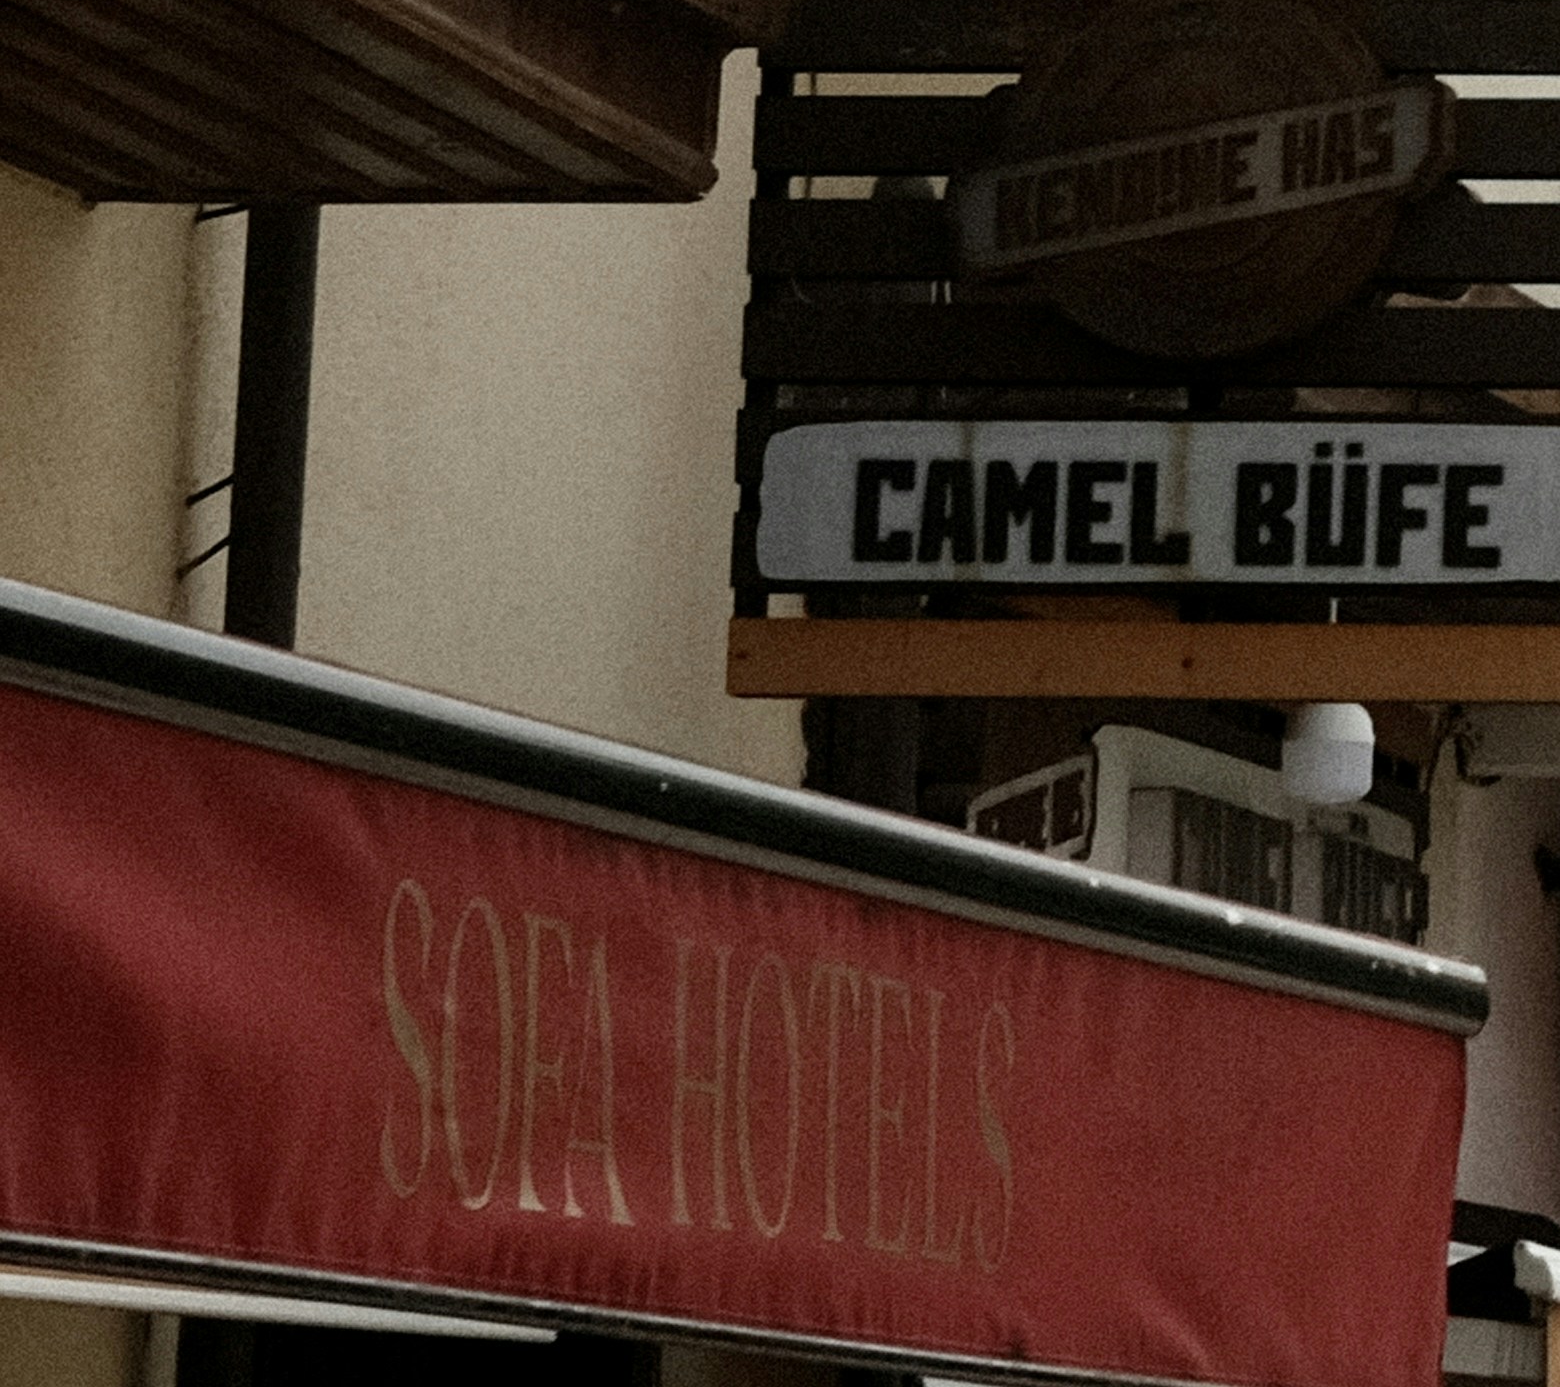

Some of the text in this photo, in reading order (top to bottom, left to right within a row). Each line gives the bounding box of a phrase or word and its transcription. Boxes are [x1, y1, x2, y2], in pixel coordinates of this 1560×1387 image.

[1280, 101, 1397, 193] HAS
[852, 442, 1505, 569] CAMEL BÜFE
[379, 878, 1016, 1275] SOFA HOTELS
